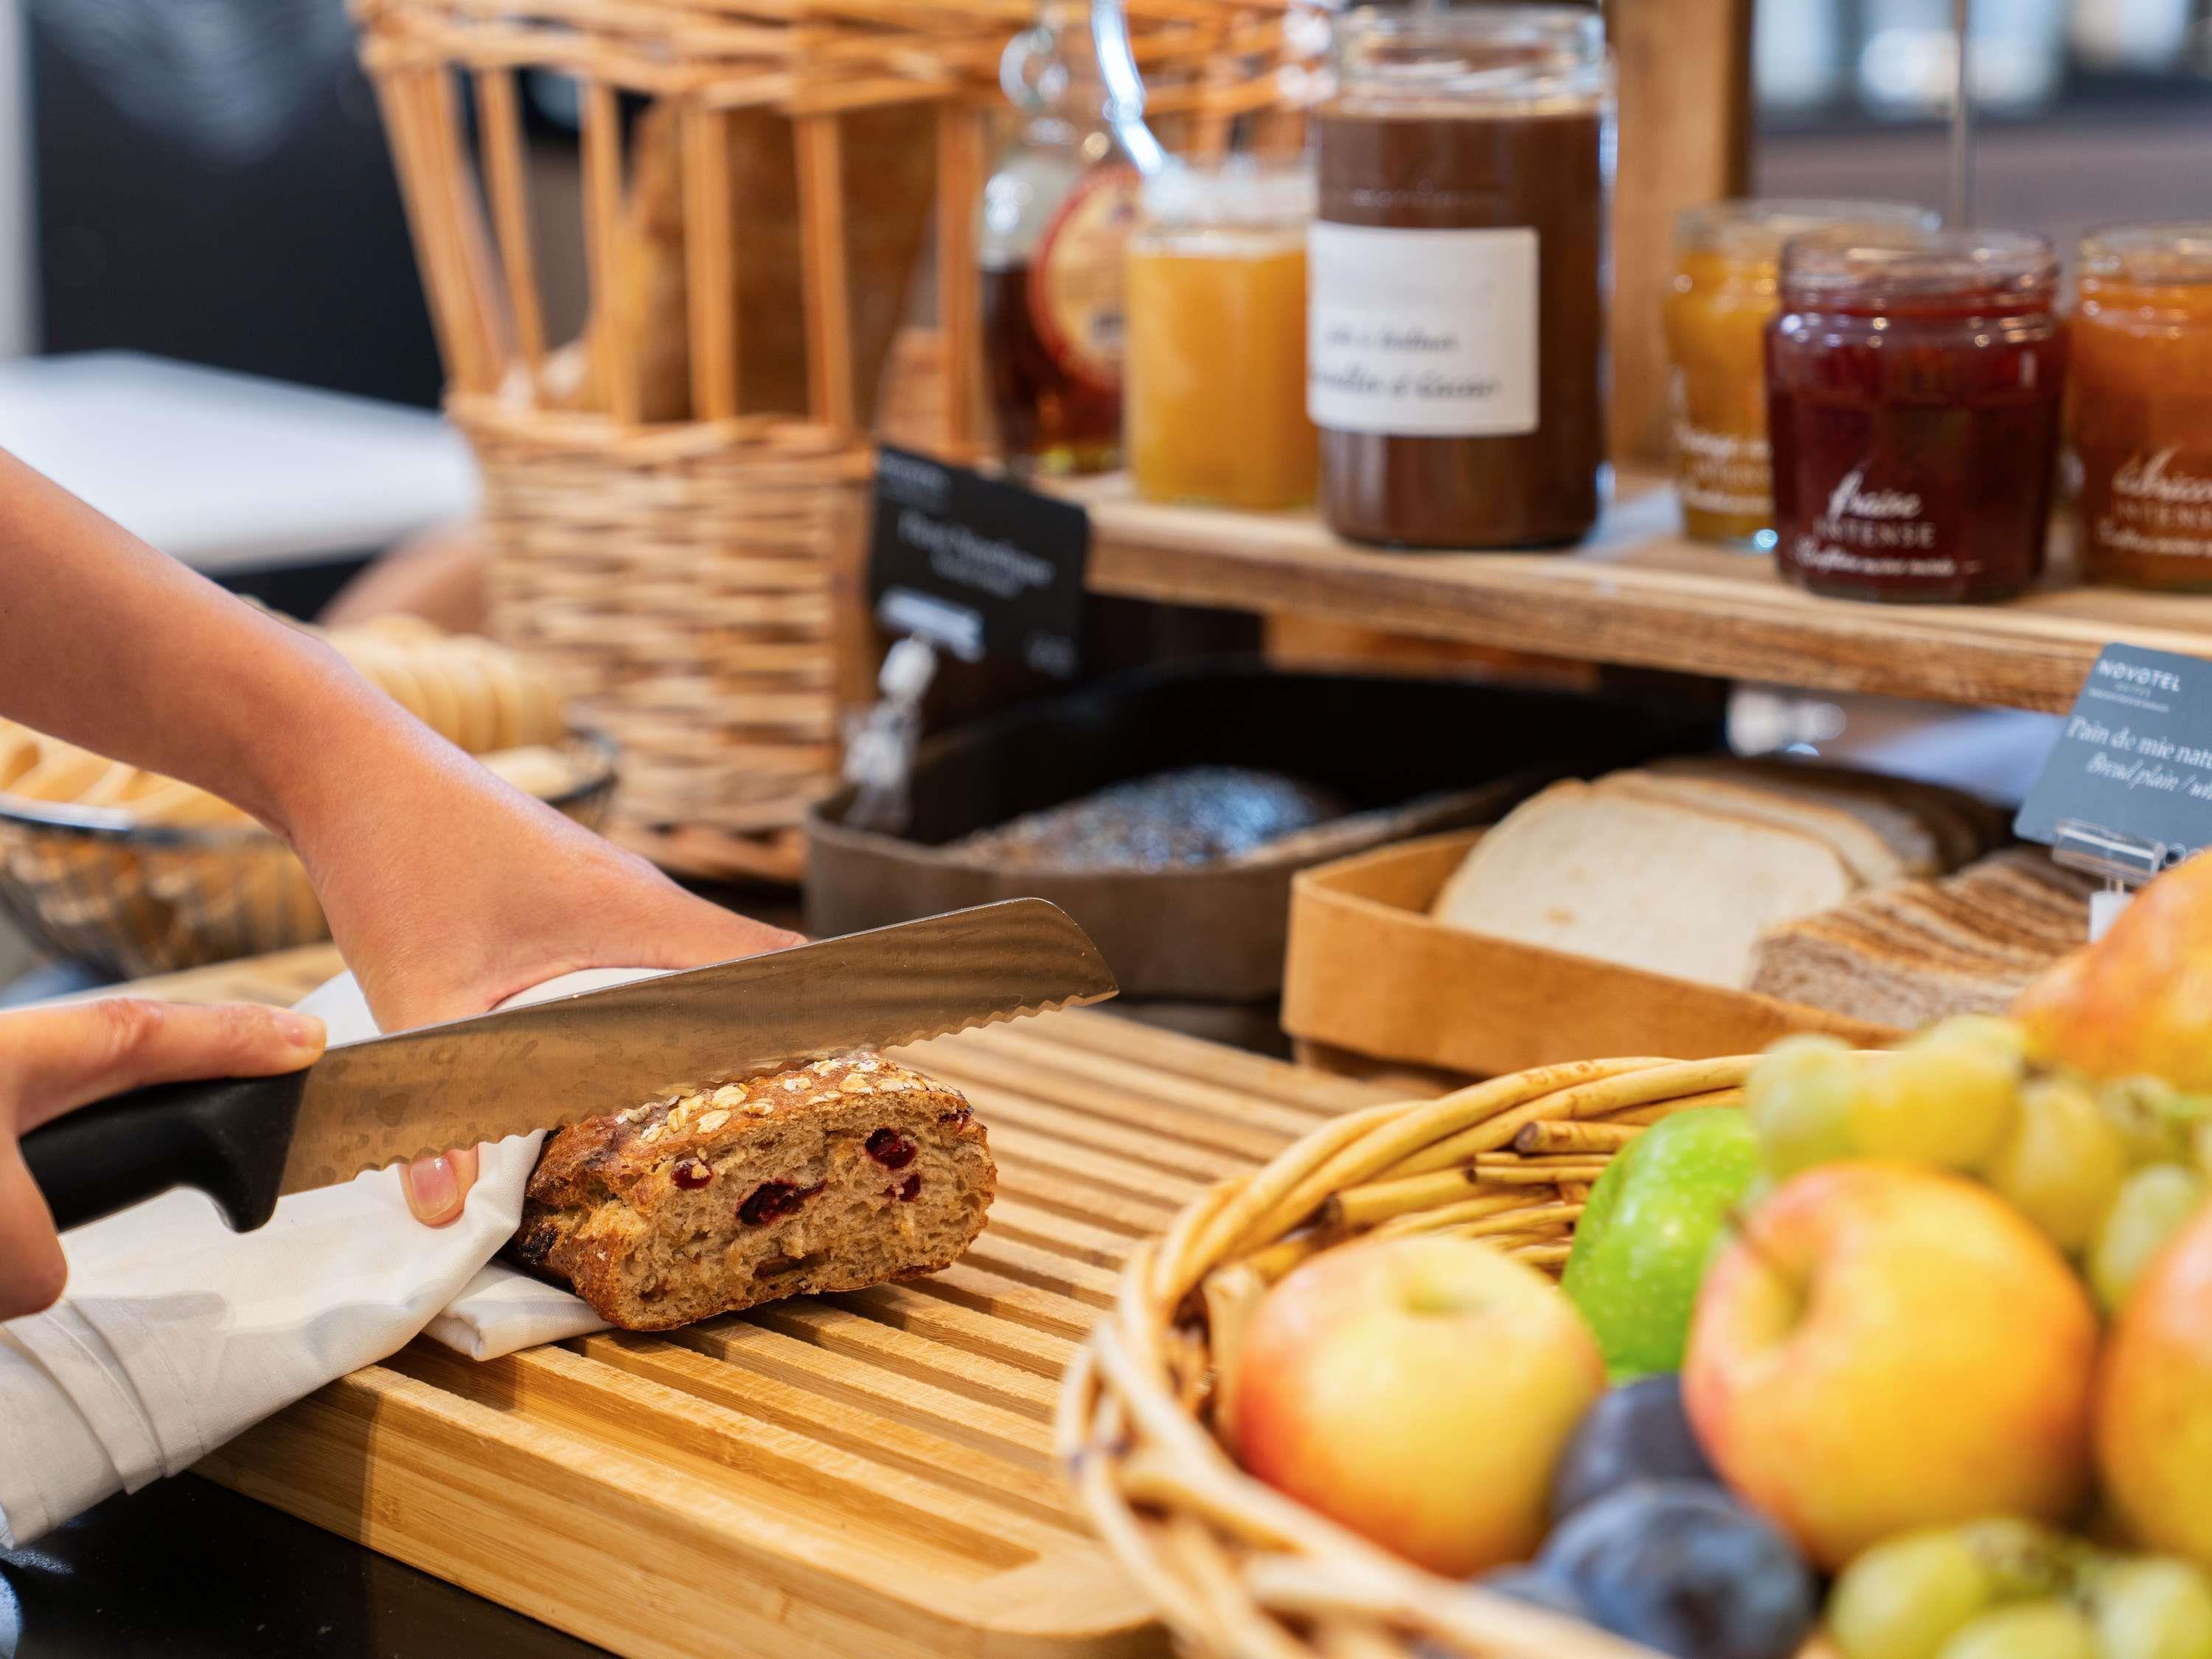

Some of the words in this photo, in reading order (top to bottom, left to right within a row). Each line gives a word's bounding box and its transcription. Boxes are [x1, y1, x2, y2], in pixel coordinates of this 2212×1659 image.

[1813, 515, 1936, 549] INTENSE
[2098, 660, 2180, 692] NOVOTEL
[2067, 716, 2110, 745] Pain
[2110, 726, 2137, 751] de
[2137, 736, 2175, 759] mie
